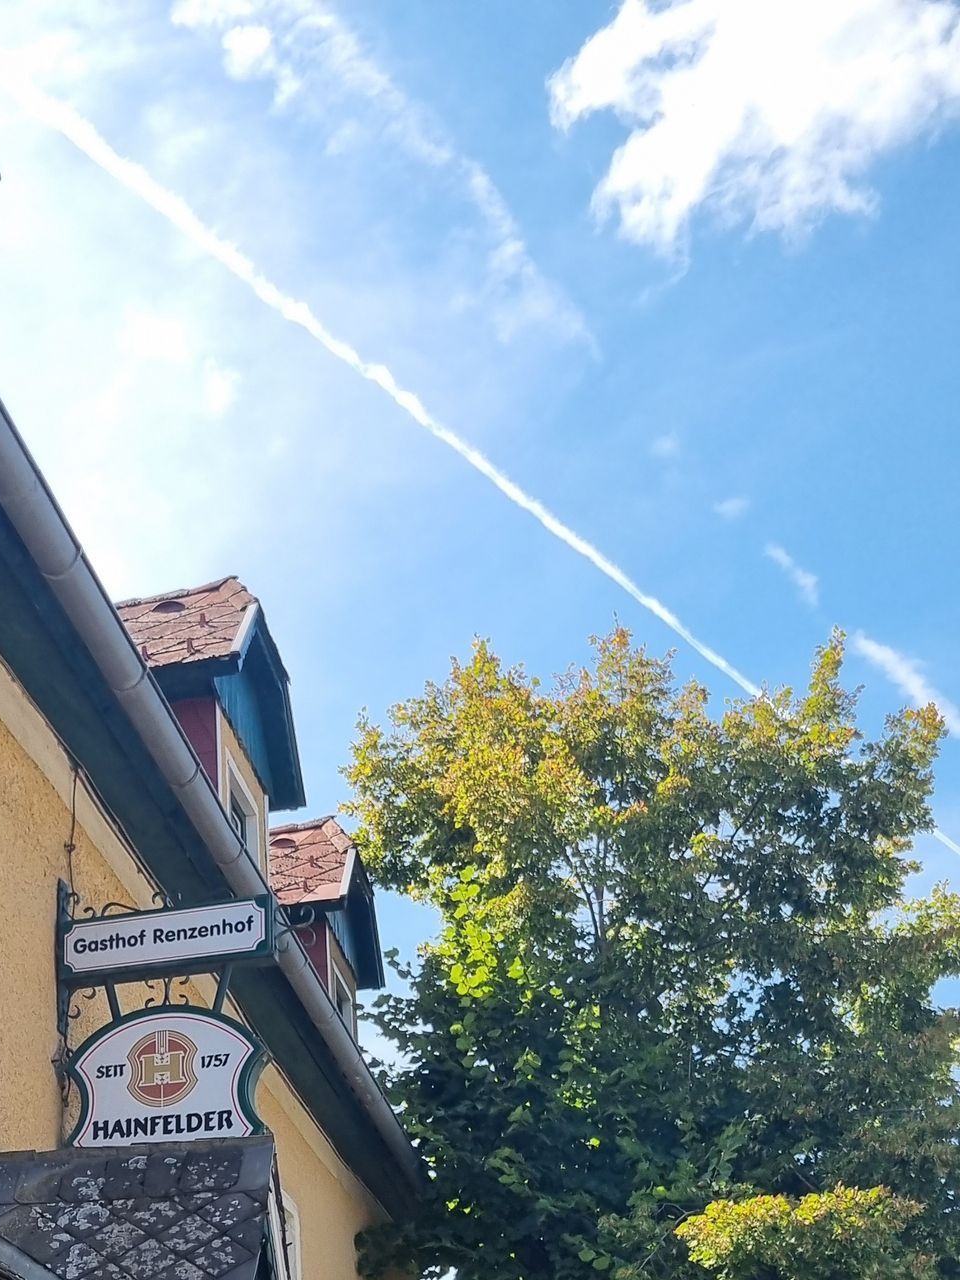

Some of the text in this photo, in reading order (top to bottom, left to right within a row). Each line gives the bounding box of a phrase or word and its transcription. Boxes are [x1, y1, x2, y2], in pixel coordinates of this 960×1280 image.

[73, 915, 255, 954] Gasthof Renzenhof
[96, 1053, 230, 1079] SEIT 1757
[92, 1110, 233, 1140] HAINFELDER
